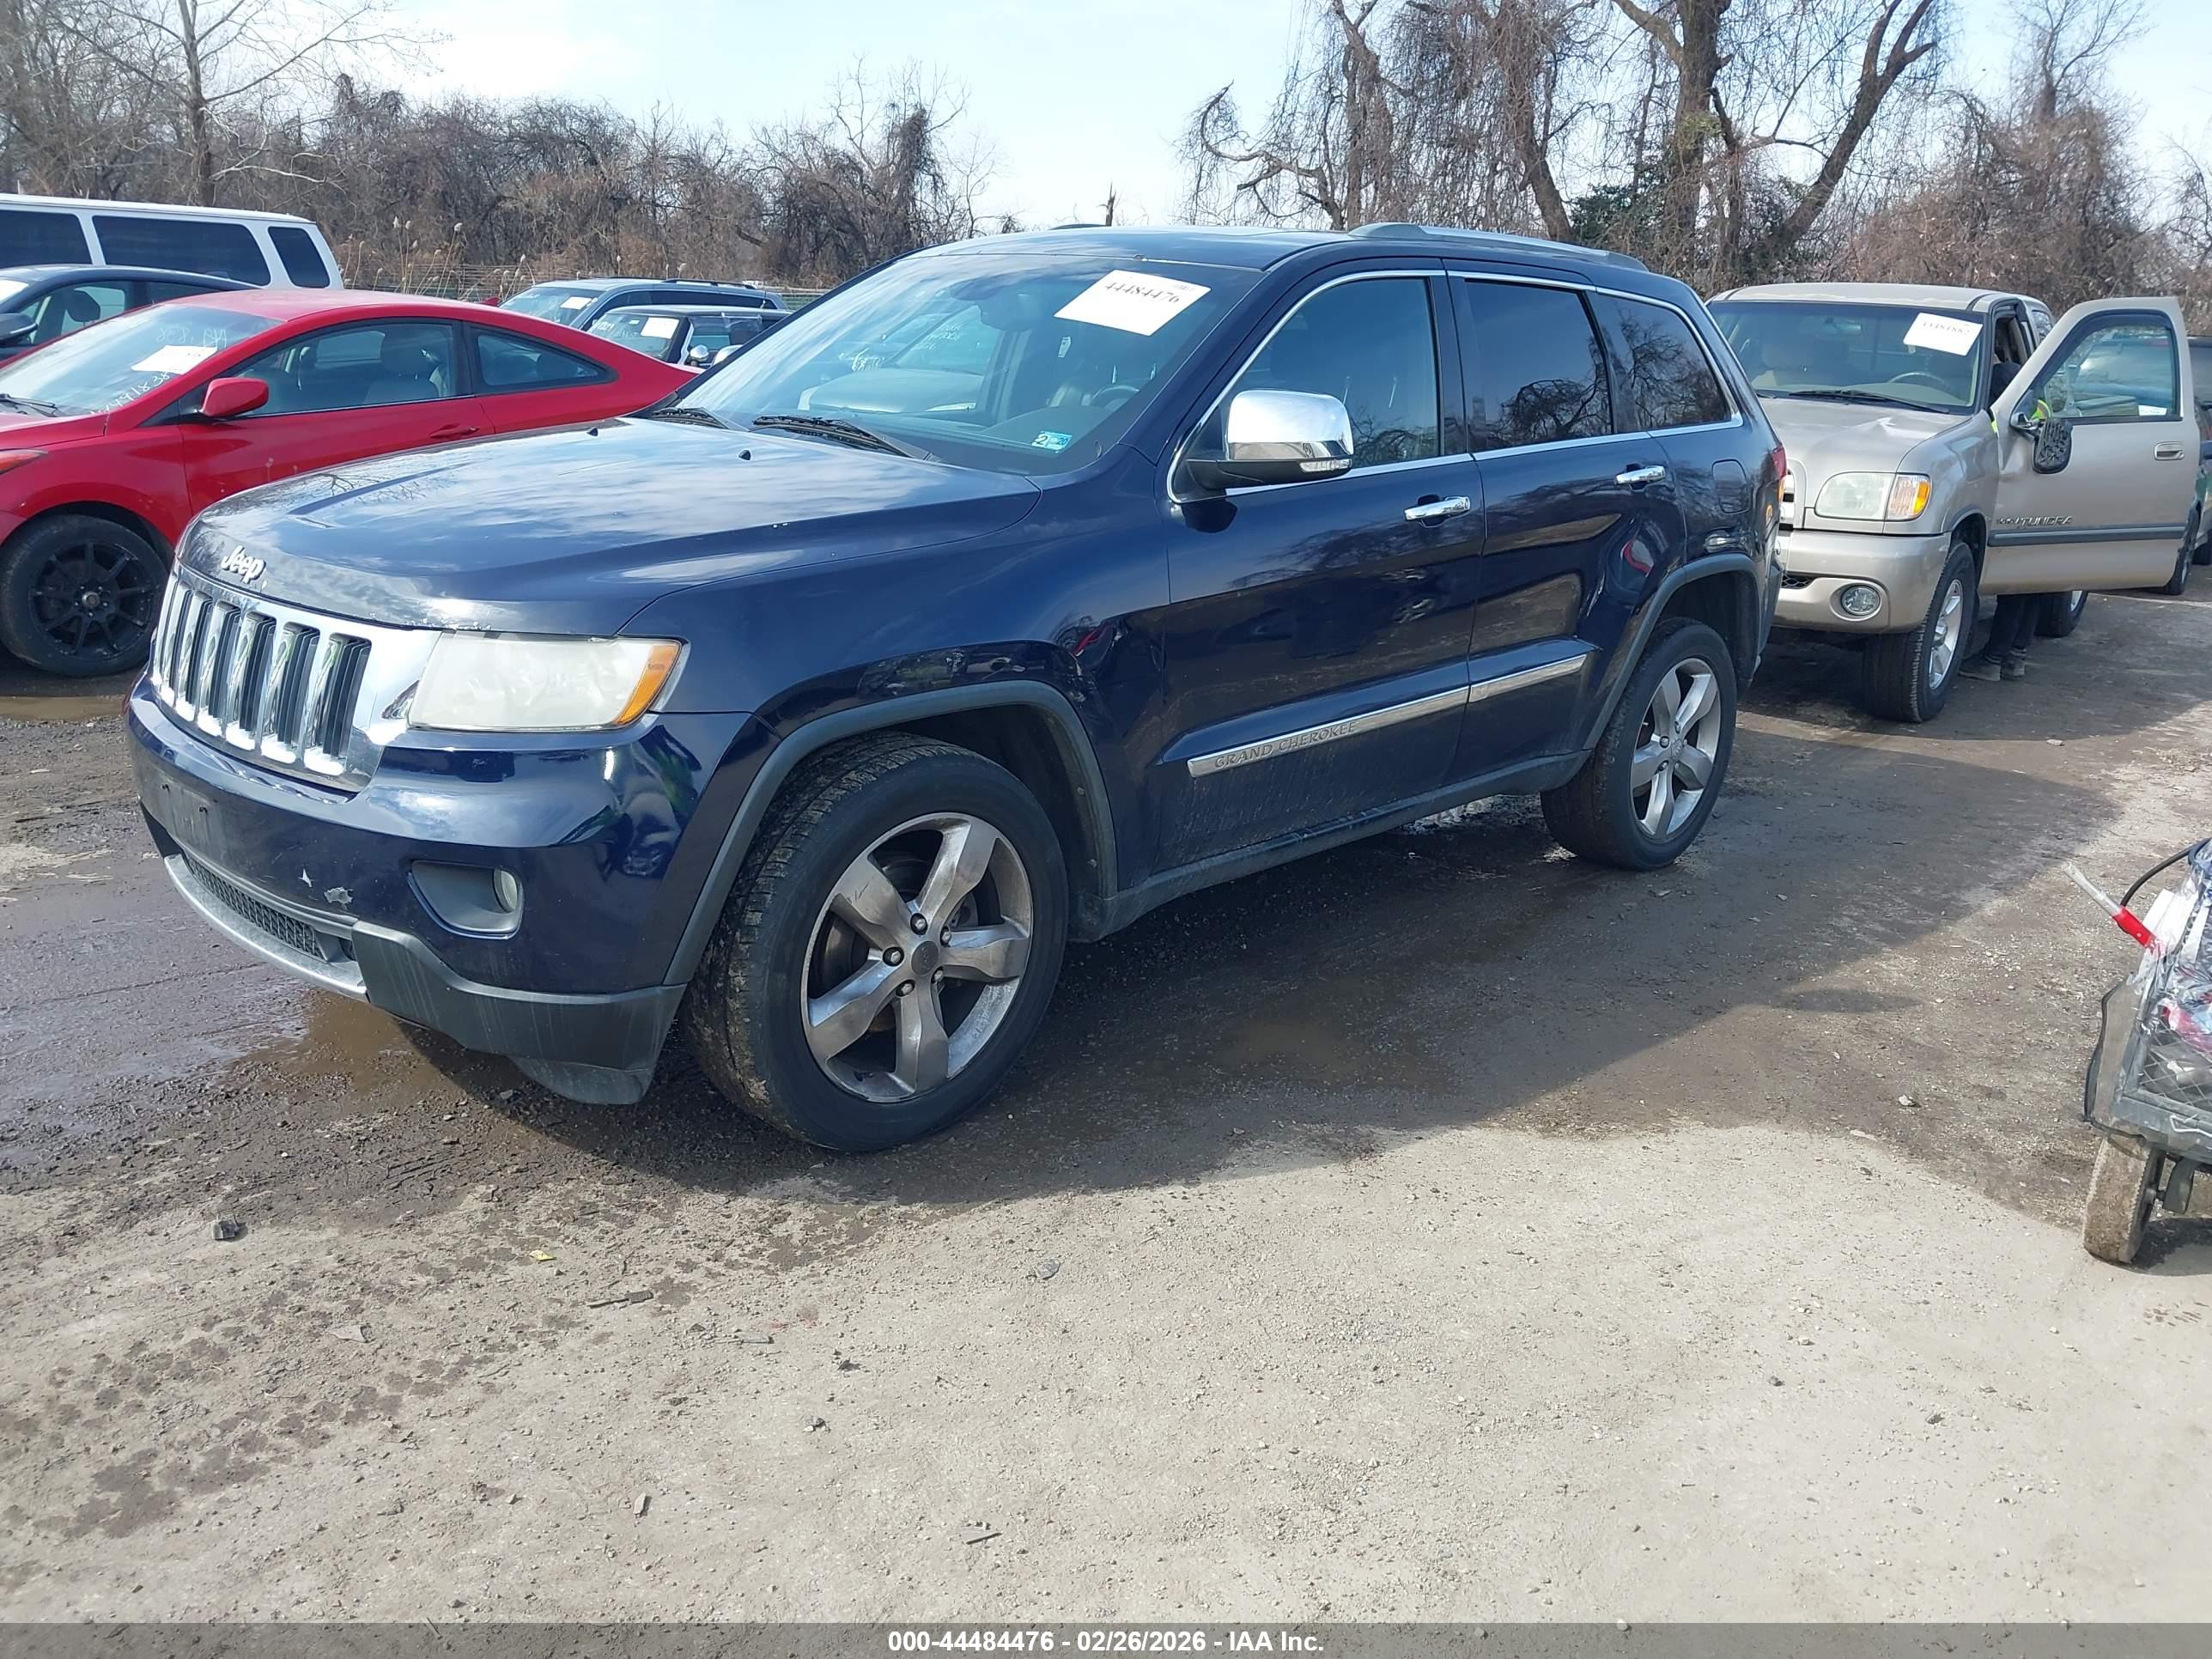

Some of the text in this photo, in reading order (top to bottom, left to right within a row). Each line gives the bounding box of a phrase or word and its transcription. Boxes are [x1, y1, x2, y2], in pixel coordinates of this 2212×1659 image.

[1105, 282, 1181, 303] 44484476
[221, 545, 266, 584] Jeep
[1214, 721, 1356, 769] GRAND CHEROKEE
